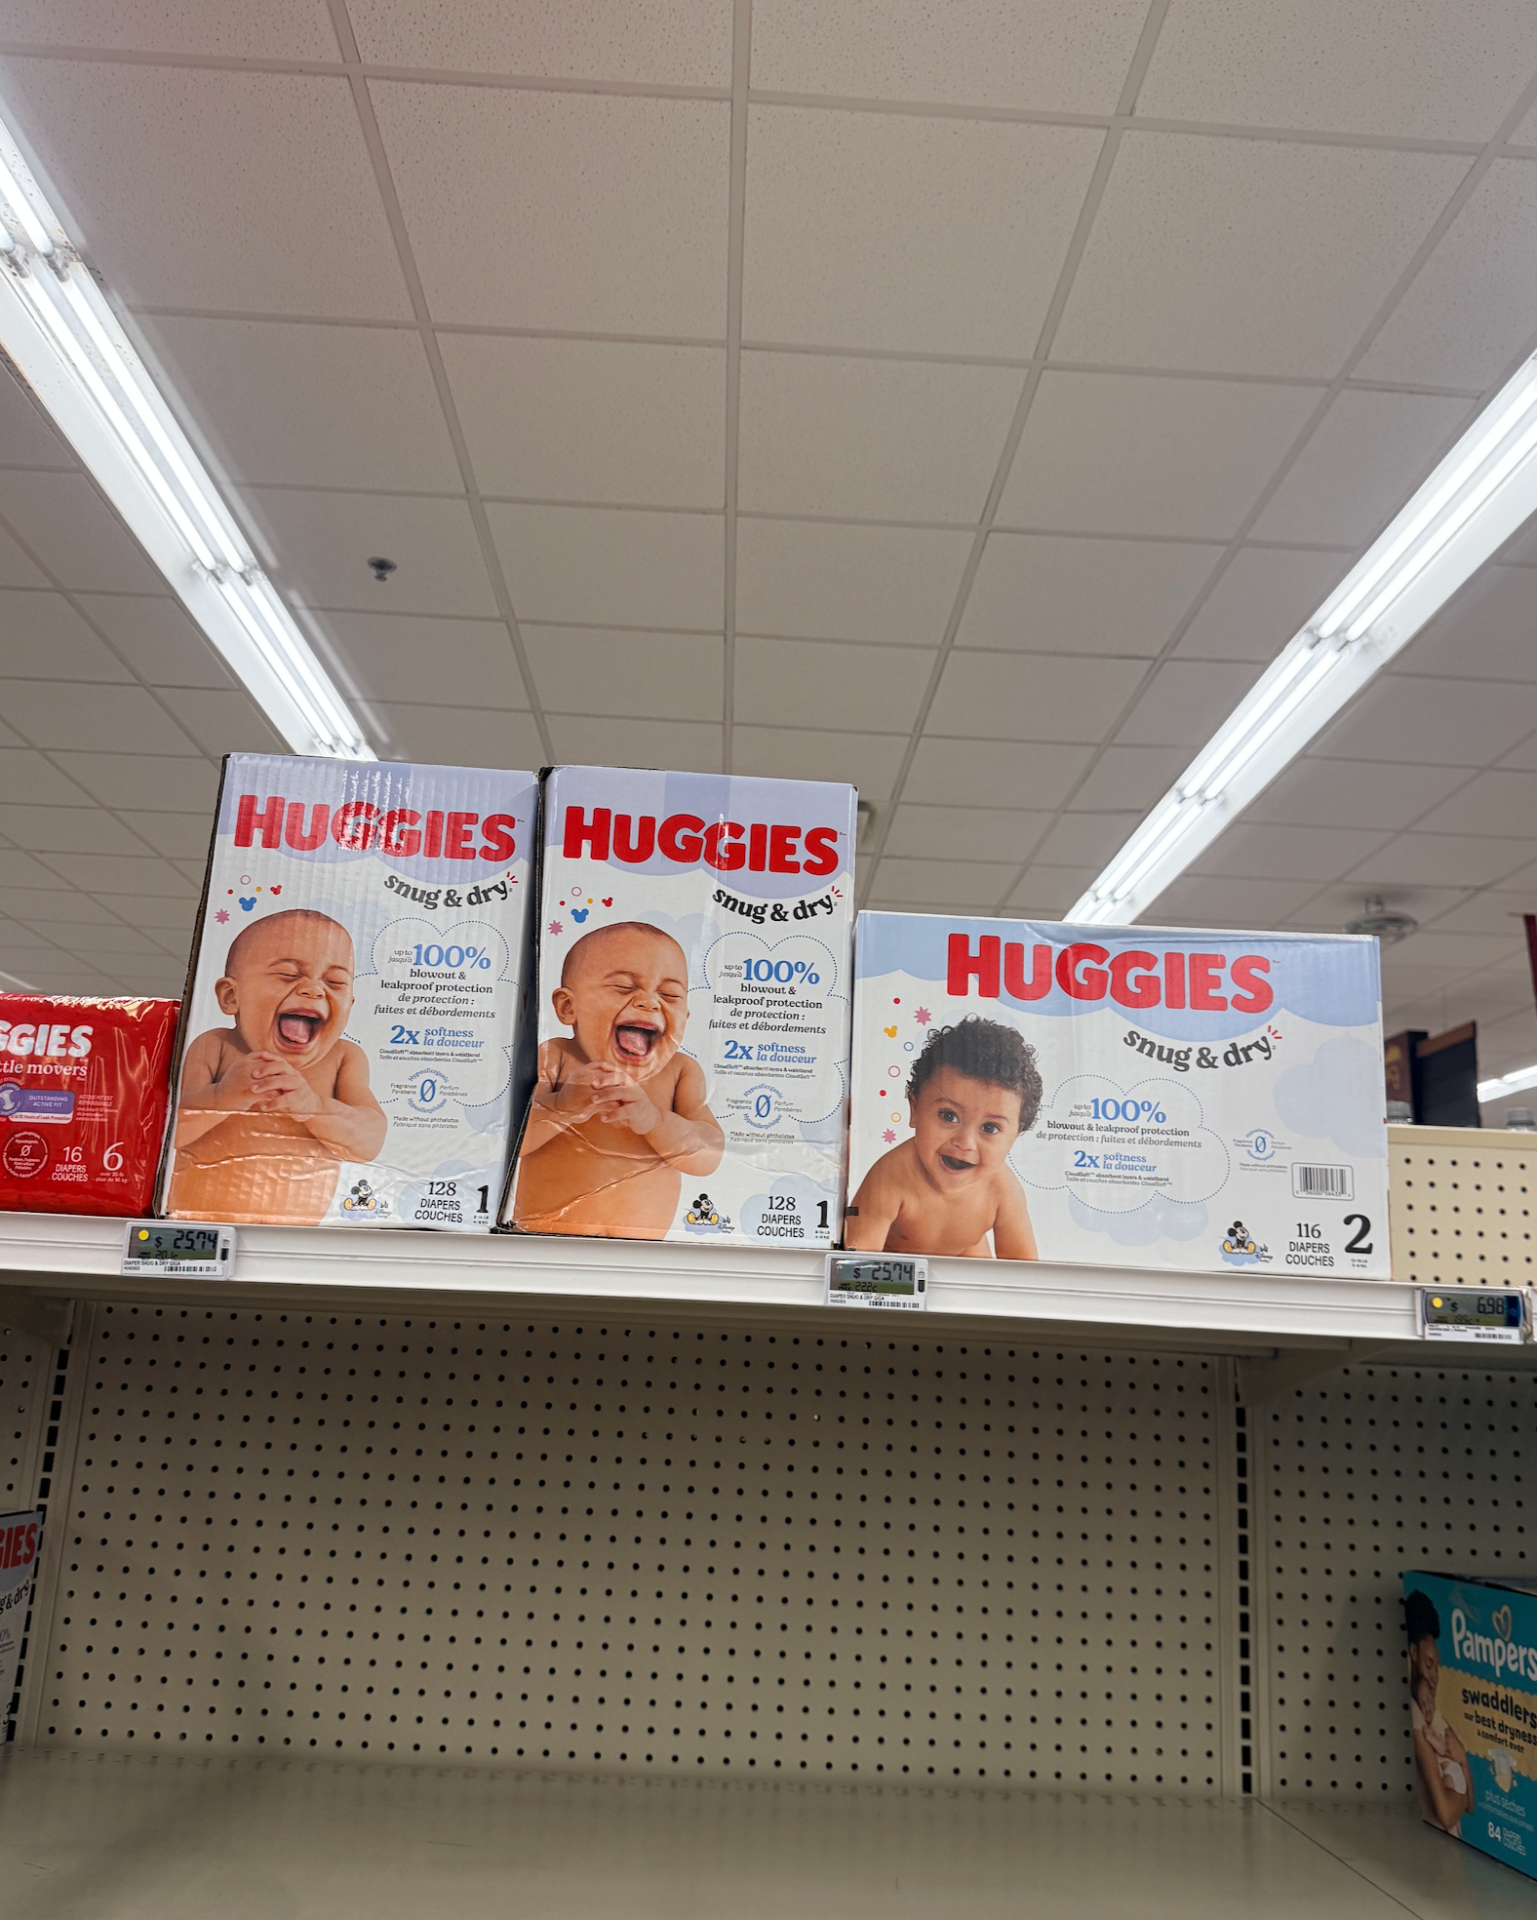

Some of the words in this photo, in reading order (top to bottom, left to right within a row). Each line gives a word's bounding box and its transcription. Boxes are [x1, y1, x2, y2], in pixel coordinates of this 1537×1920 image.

[234, 794, 516, 862] HUGGIES
[563, 806, 839, 876] HUGGIES
[384, 875, 442, 910] snug
[443, 889, 462, 907] &
[467, 880, 510, 906] dry
[712, 889, 769, 924] snug
[770, 904, 789, 922] &
[792, 895, 834, 920] dry
[413, 944, 491, 970] 100%
[410, 969, 456, 979] blowout
[458, 971, 466, 980] &
[743, 958, 820, 984] 100%
[947, 933, 1274, 1014] HUGGIES
[381, 980, 434, 991] leakproof
[435, 983, 493, 994] protection
[741, 983, 786, 995] blowout
[788, 986, 796, 995] &
[398, 993, 411, 1002] de
[412, 995, 470, 1005] protection
[713, 995, 765, 1006] leakproof
[766, 999, 822, 1009] protection
[374, 1005, 404, 1015] fuites
[407, 1006, 417, 1015] et
[419, 1006, 496, 1018] débordements
[730, 1008, 742, 1017] de
[744, 1010, 800, 1020] protection
[425, 1027, 473, 1038] softness
[708, 1019, 737, 1029] fuites
[739, 1021, 749, 1030] et
[751, 1021, 826, 1034] débordements
[390, 1025, 420, 1045] 2x
[423, 1036, 434, 1046] la
[437, 1037, 485, 1048] douceur
[724, 1040, 753, 1060] 2x
[757, 1042, 806, 1053] softness
[1123, 1029, 1192, 1072] snug
[1196, 1046, 1219, 1069] &
[1223, 1035, 1273, 1067] dry
[756, 1051, 767, 1061] la
[769, 1052, 817, 1064] douceur
[27, 1062, 87, 1076] movers
[1090, 1098, 1167, 1123] 100%
[1047, 1121, 1085, 1131] blowout
[1095, 1124, 1139, 1134] leakproof
[1141, 1127, 1189, 1137] protection
[1036, 1131, 1047, 1139] de
[1048, 1132, 1094, 1142] protection
[1100, 1134, 1126, 1144] fuites
[1127, 1136, 1136, 1144] et
[1138, 1137, 1202, 1148] débordements
[63, 1146, 83, 1162] 16
[103, 1142, 124, 1171] 6
[1074, 1150, 1100, 1168] 2x
[1103, 1152, 1147, 1163] softness
[55, 1164, 87, 1173] DIAPERS
[1102, 1160, 1113, 1170] la
[1115, 1161, 1157, 1172] douceur
[51, 1173, 89, 1182] COUCHES
[428, 1181, 457, 1196] 128
[420, 1199, 461, 1211] DIAPERS
[476, 1185, 489, 1213] 1
[768, 1196, 796, 1211] 128
[415, 1210, 463, 1223] COUCHES
[761, 1213, 801, 1225] DIAPERS
[816, 1200, 829, 1228] 1
[757, 1225, 805, 1238] COUCHES
[1296, 1222, 1321, 1239] 116
[1343, 1214, 1373, 1254] 2
[1289, 1241, 1330, 1254] DIAPERS
[1285, 1253, 1334, 1266] COUCHES
[853, 1267, 861, 1279] $
[872, 1262, 913, 1282] 25.74
[1452, 1608, 1537, 1681] Pampers
[1462, 1688, 1537, 1730] swaddlers
[1475, 1710, 1497, 1730] best
[1498, 1721, 1537, 1746] dryness
[1481, 1730, 1508, 1747] comfort
[1509, 1741, 1524, 1753] ever
[1488, 1822, 1501, 1842] 84
